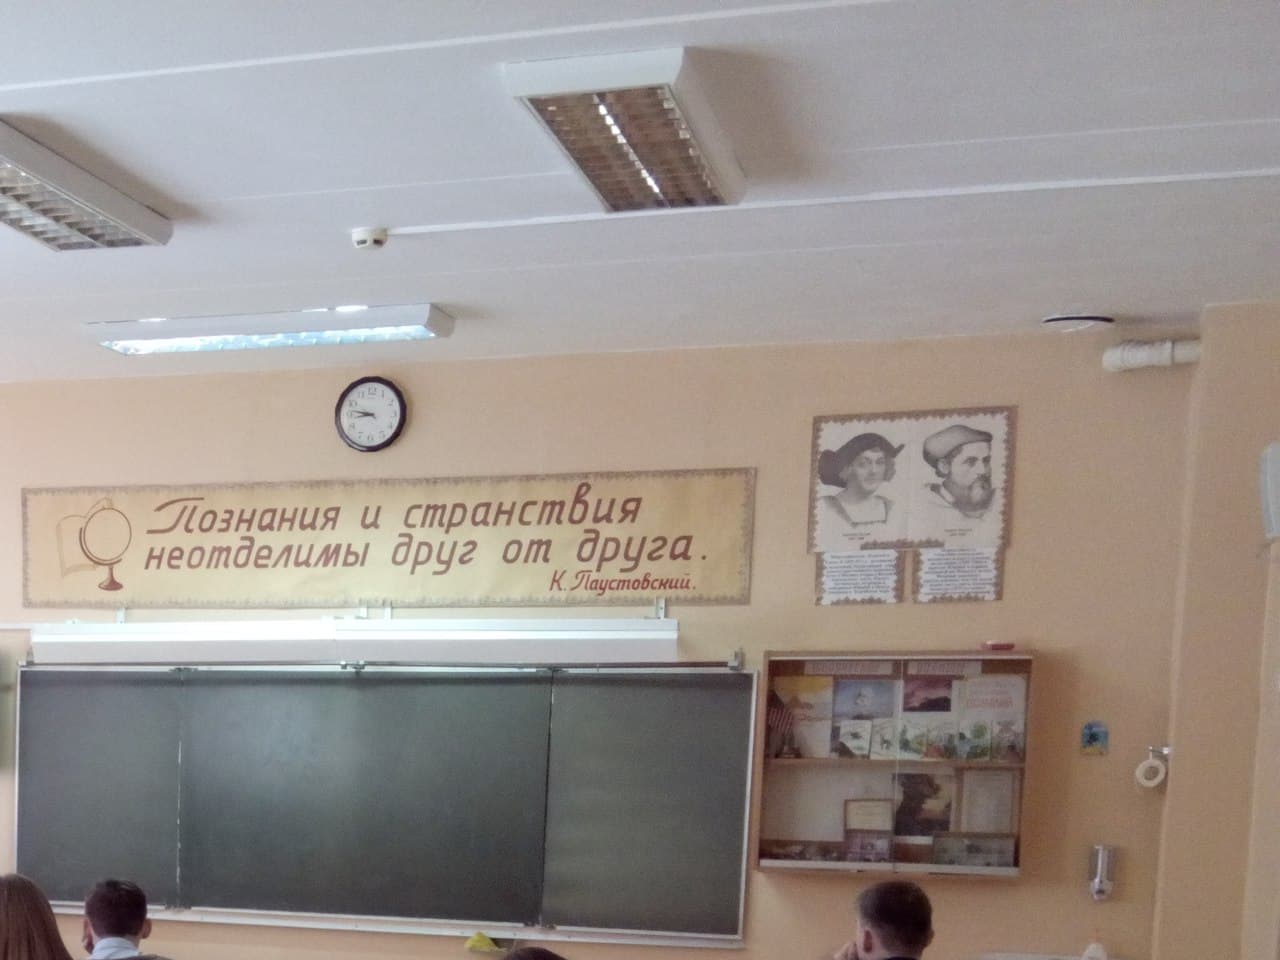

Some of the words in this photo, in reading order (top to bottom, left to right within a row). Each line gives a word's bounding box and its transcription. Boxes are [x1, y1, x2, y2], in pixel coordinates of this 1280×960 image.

[146, 497, 341, 534] Познания
[360, 504, 382, 530] и
[403, 482, 643, 533] странствия
[144, 535, 371, 570] неотделимы
[390, 532, 478, 576] друг
[501, 537, 552, 564] от
[576, 528, 708, 573] друга.
